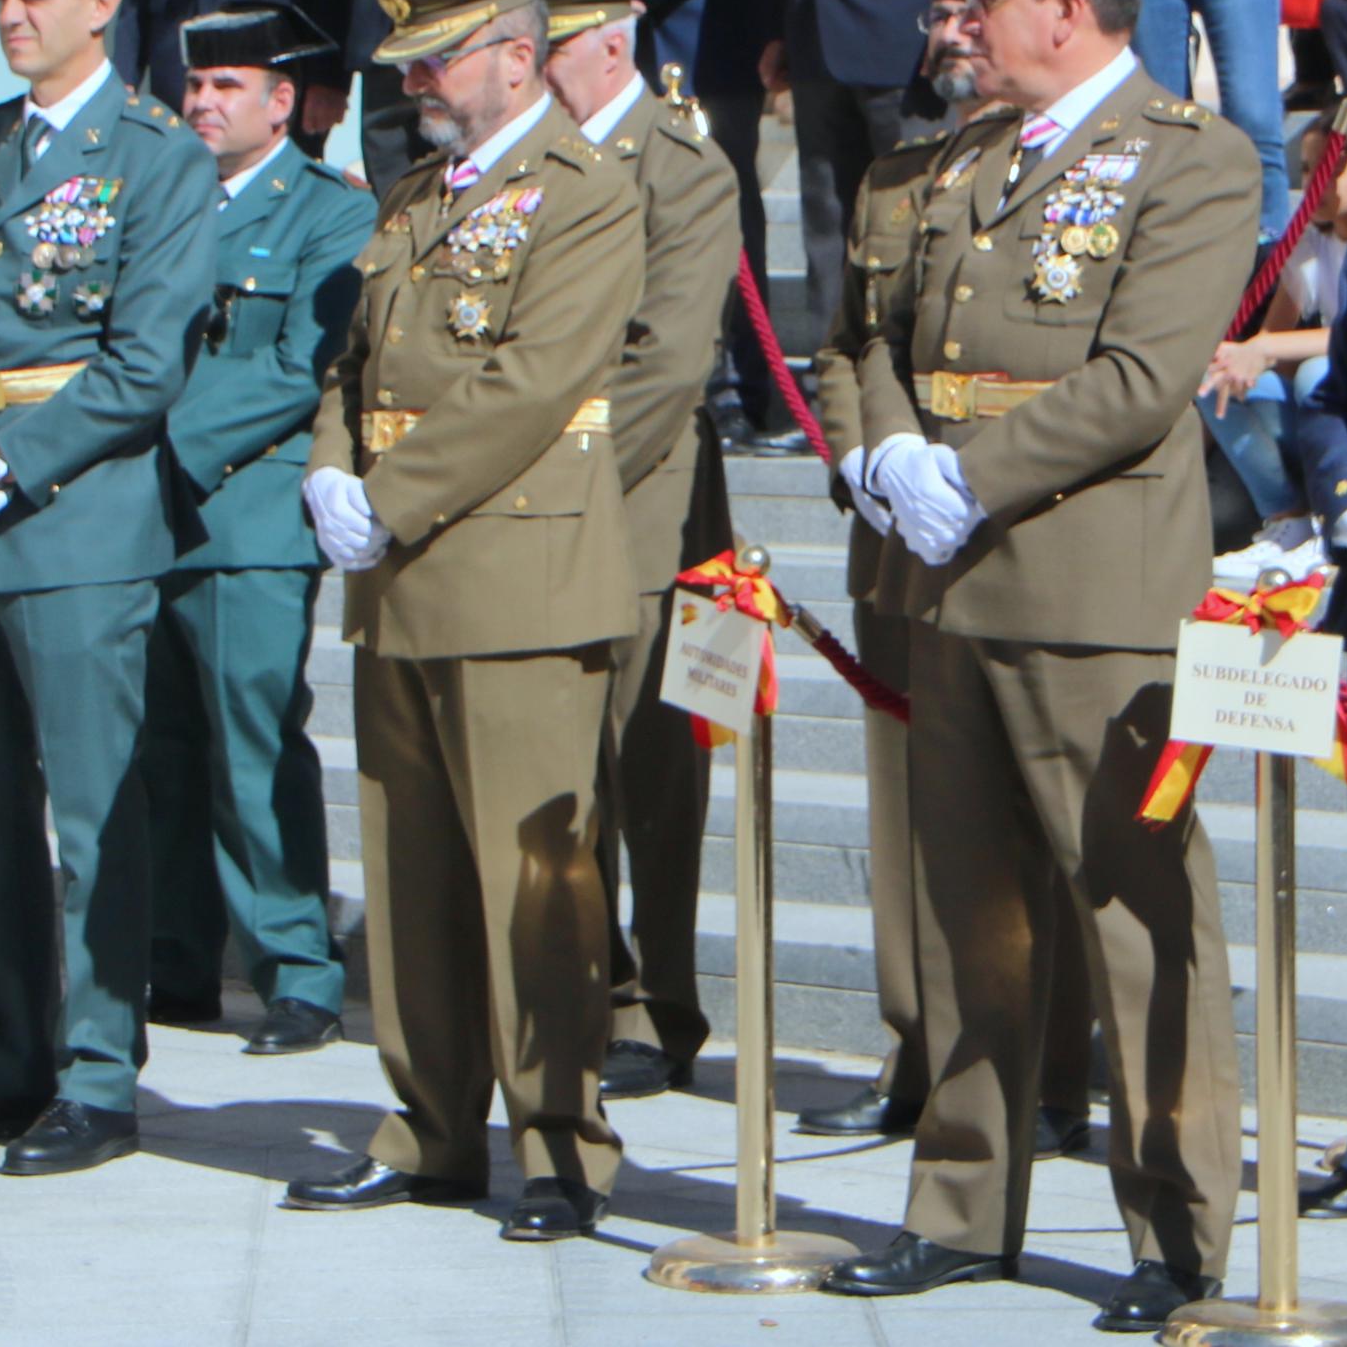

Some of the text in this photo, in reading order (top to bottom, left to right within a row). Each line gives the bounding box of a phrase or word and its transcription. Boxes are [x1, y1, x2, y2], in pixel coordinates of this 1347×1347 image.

[682, 642, 749, 679] AUTORIDADES
[687, 666, 738, 698] MILITARES
[1192, 662, 1328, 693] SUBDELEGADO
[1243, 690, 1268, 708] DE
[1214, 708, 1297, 733] DEFENSA
